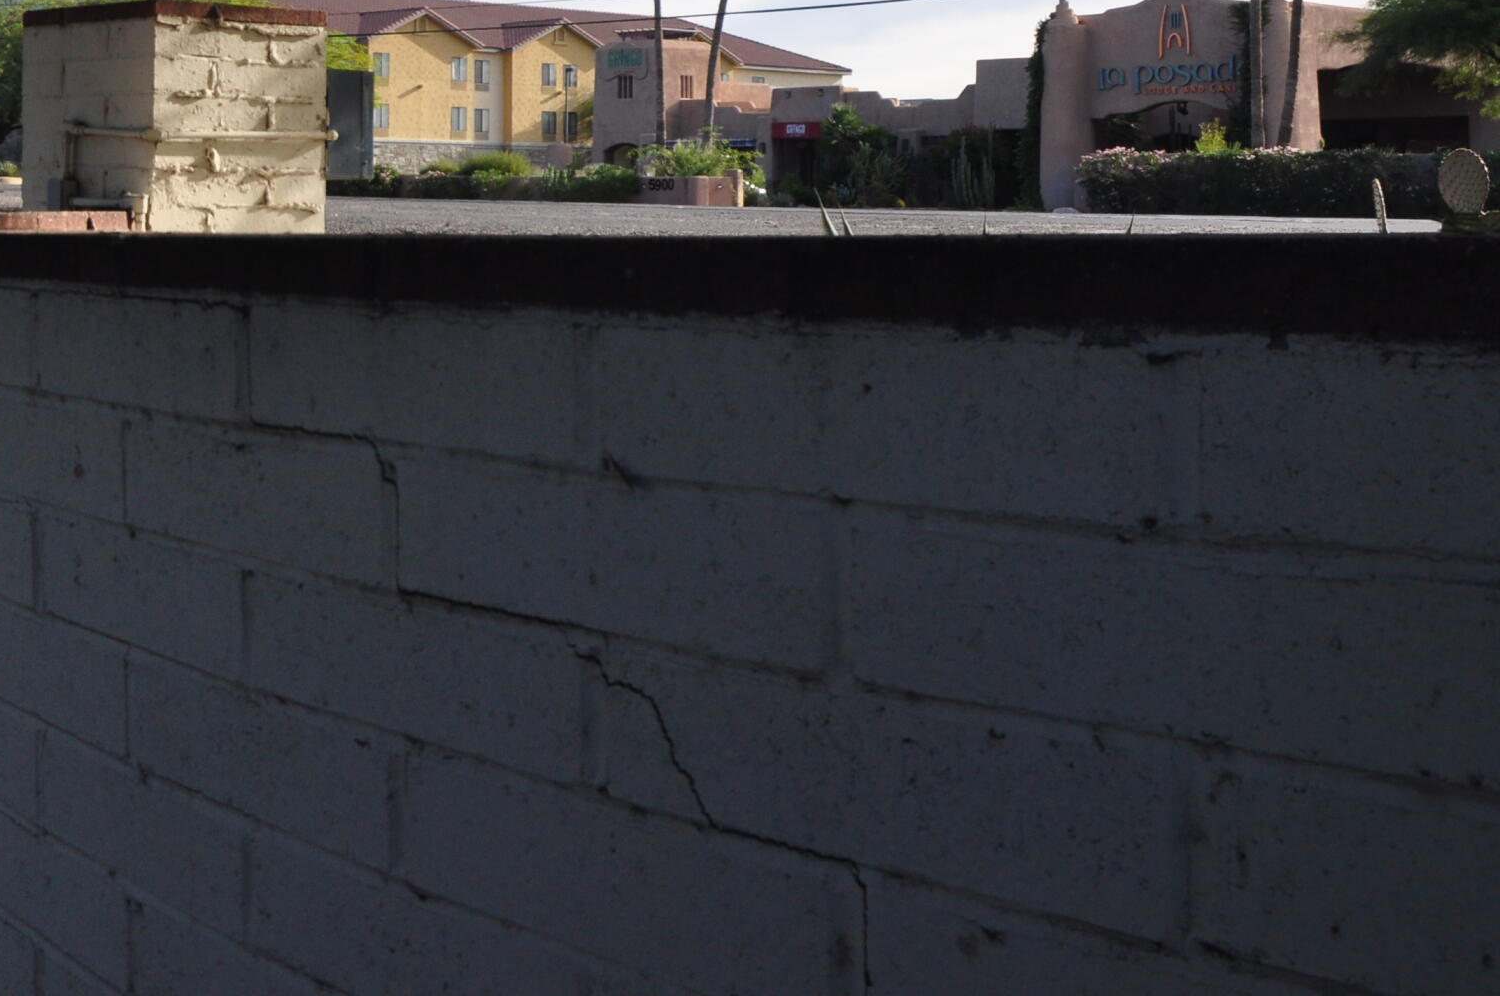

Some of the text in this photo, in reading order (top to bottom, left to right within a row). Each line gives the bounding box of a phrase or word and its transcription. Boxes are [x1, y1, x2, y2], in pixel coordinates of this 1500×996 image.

[1133, 54, 1243, 94] posad
[1182, 83, 1205, 94] AND
[649, 178, 675, 191] 5900
